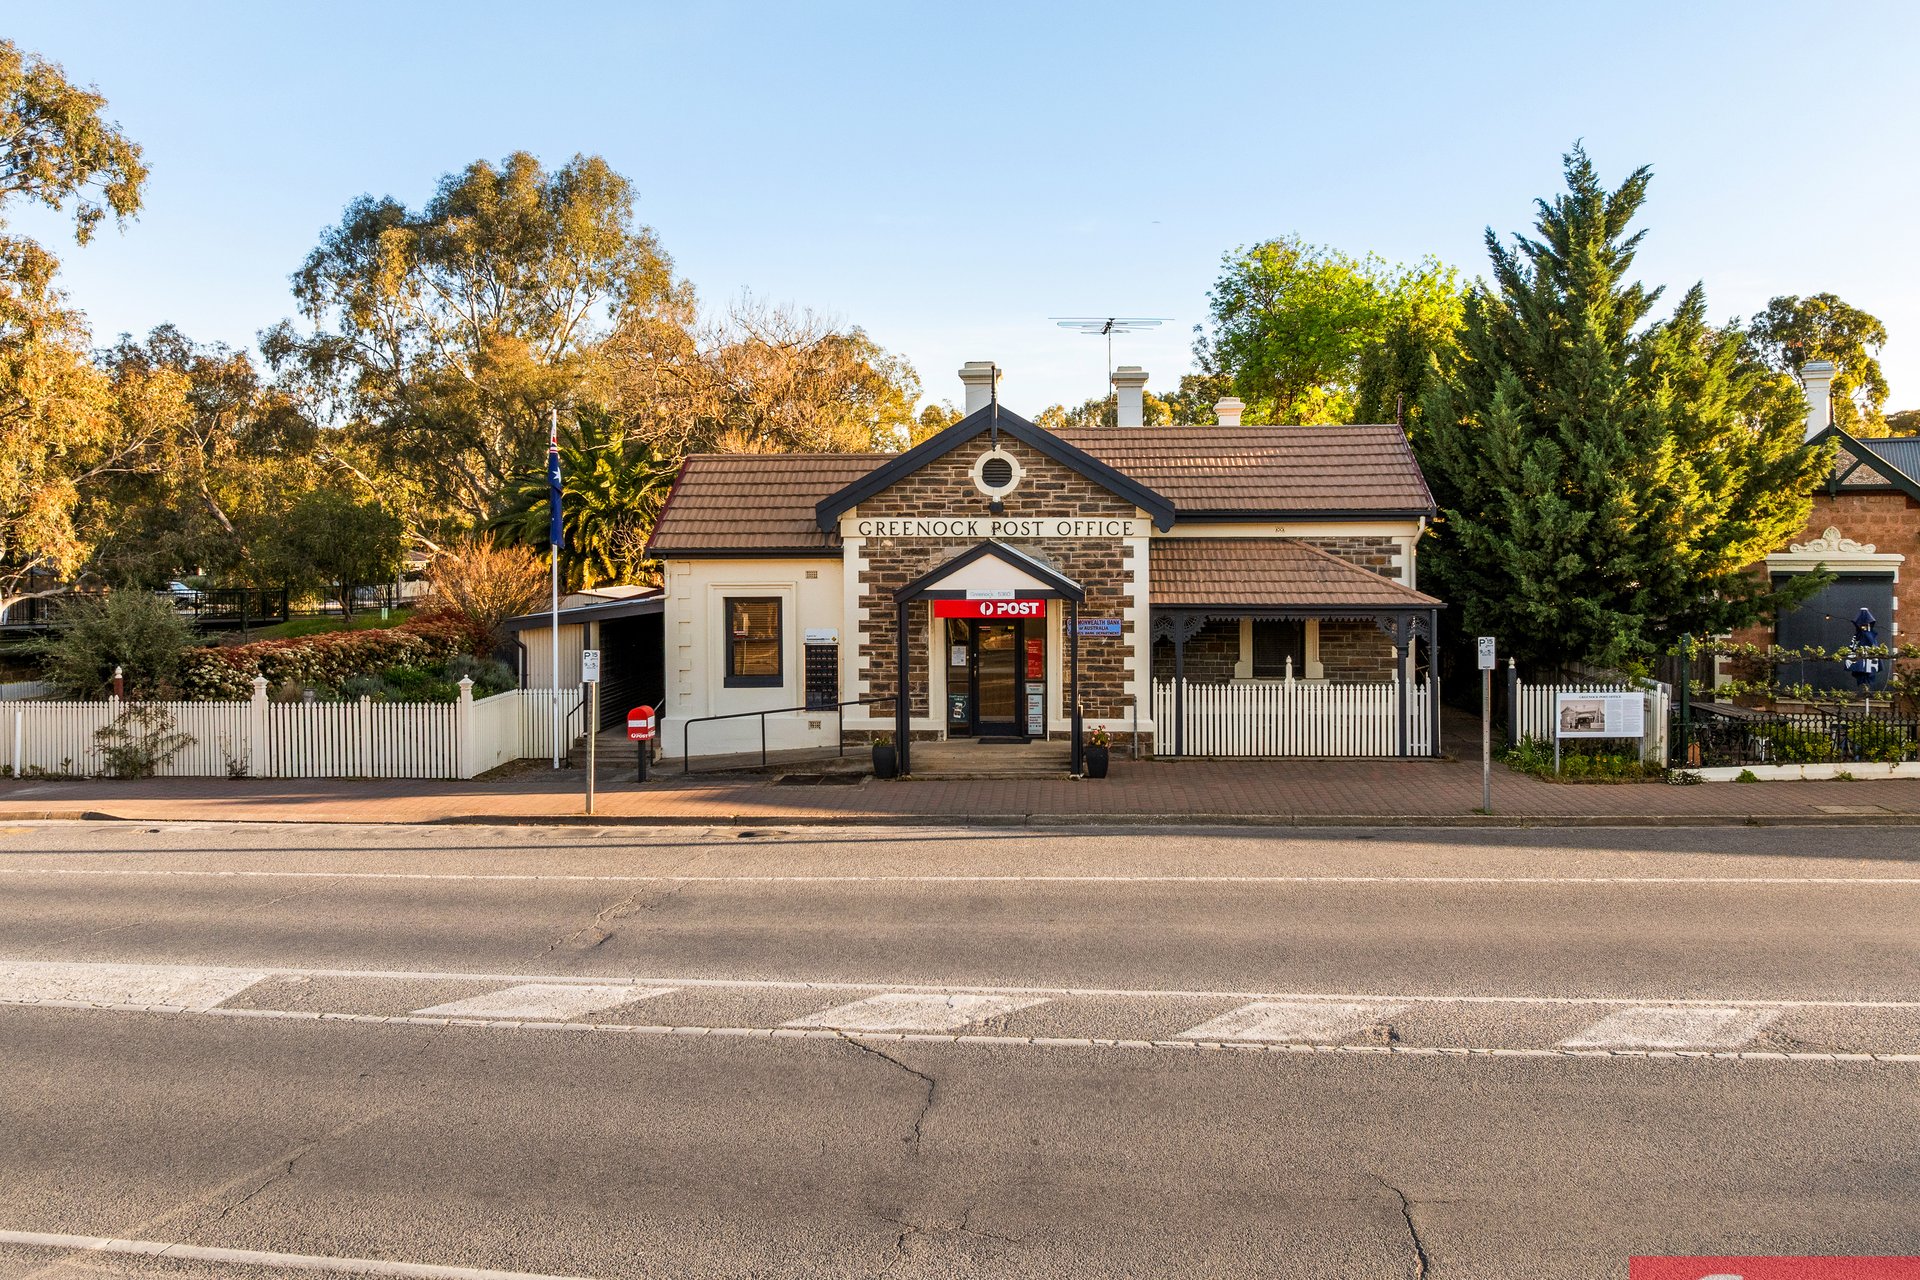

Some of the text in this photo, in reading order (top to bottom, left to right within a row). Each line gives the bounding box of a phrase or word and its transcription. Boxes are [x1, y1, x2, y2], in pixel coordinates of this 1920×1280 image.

[858, 520, 1135, 536] GREENOCK POST OFFICE
[997, 602, 1039, 615] POST
[584, 651, 591, 659] P
